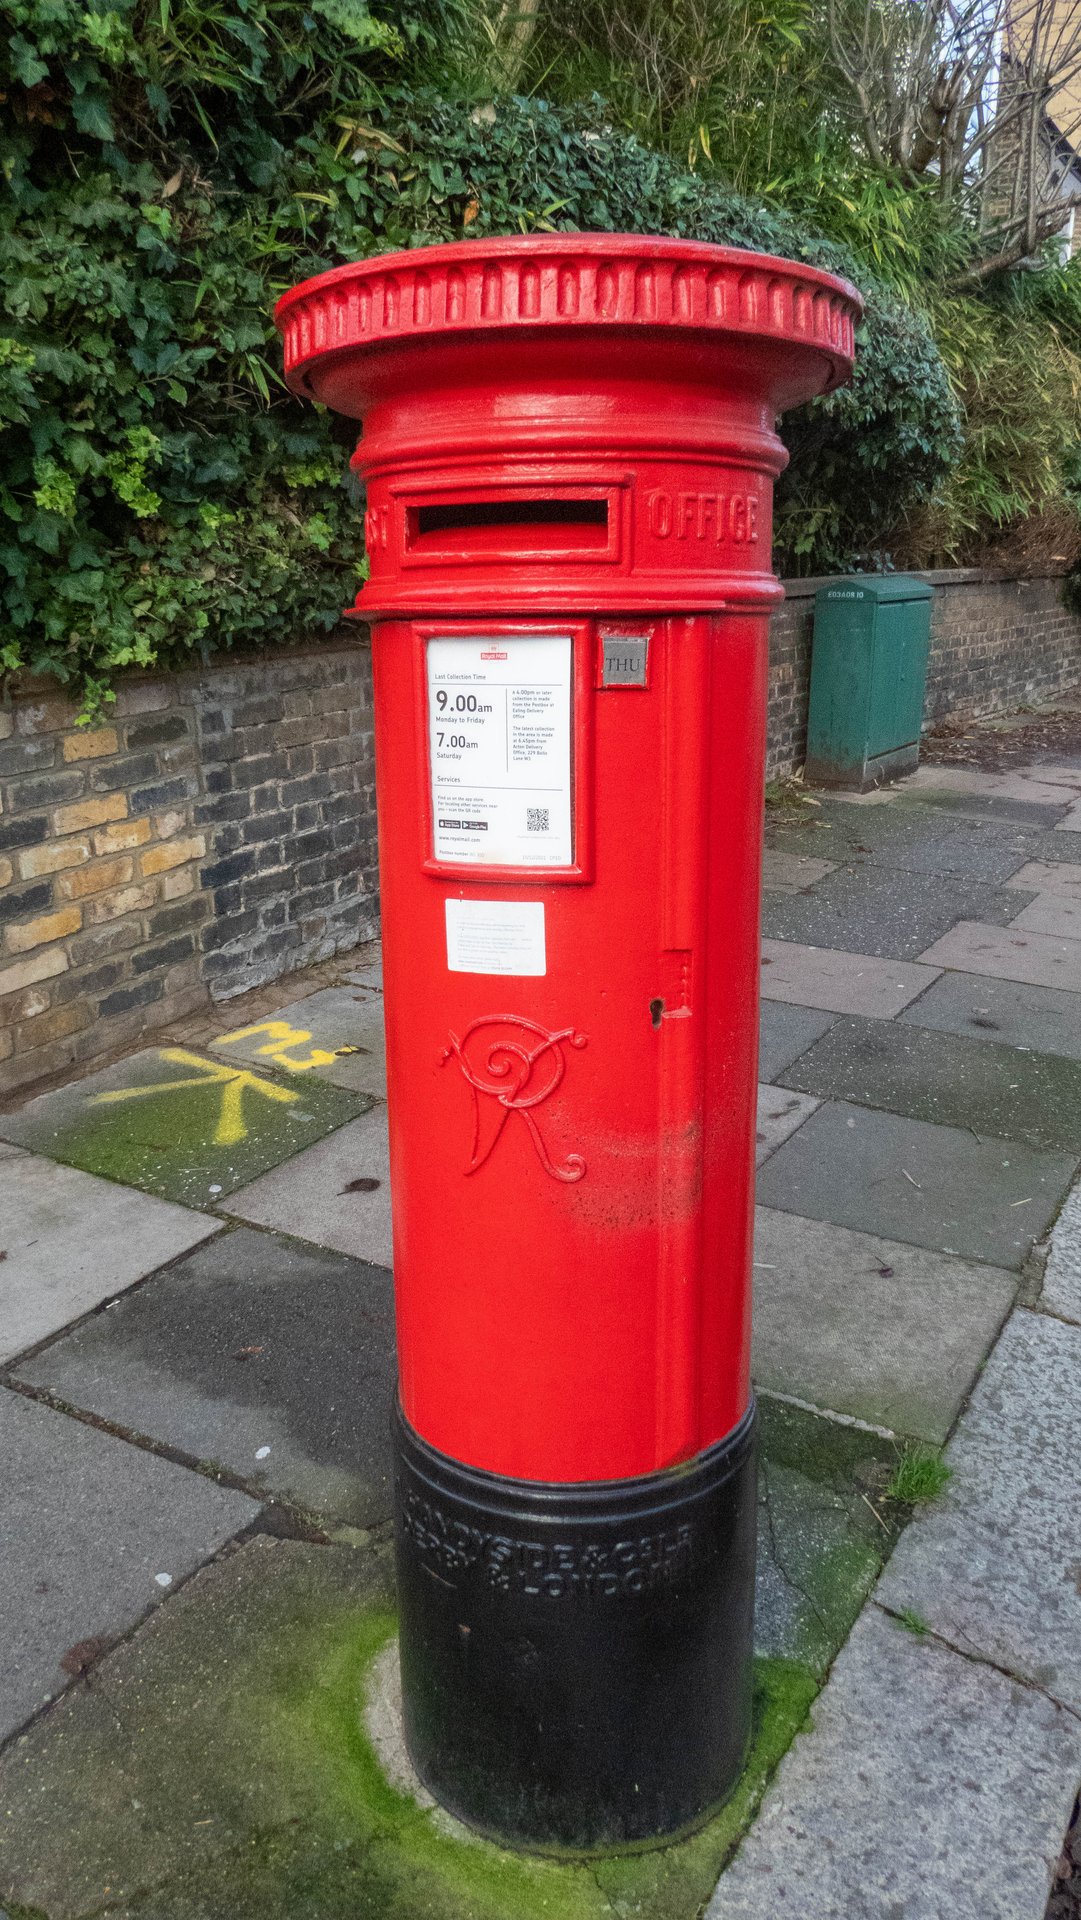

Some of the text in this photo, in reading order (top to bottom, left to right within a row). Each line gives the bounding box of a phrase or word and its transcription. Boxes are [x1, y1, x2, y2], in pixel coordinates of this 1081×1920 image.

[648, 490, 759, 543] OFFICE
[606, 658, 640, 672] THU
[436, 690, 492, 712] 9.00am
[436, 732, 478, 748] 7.00am
[437, 752, 462, 760] Saturday
